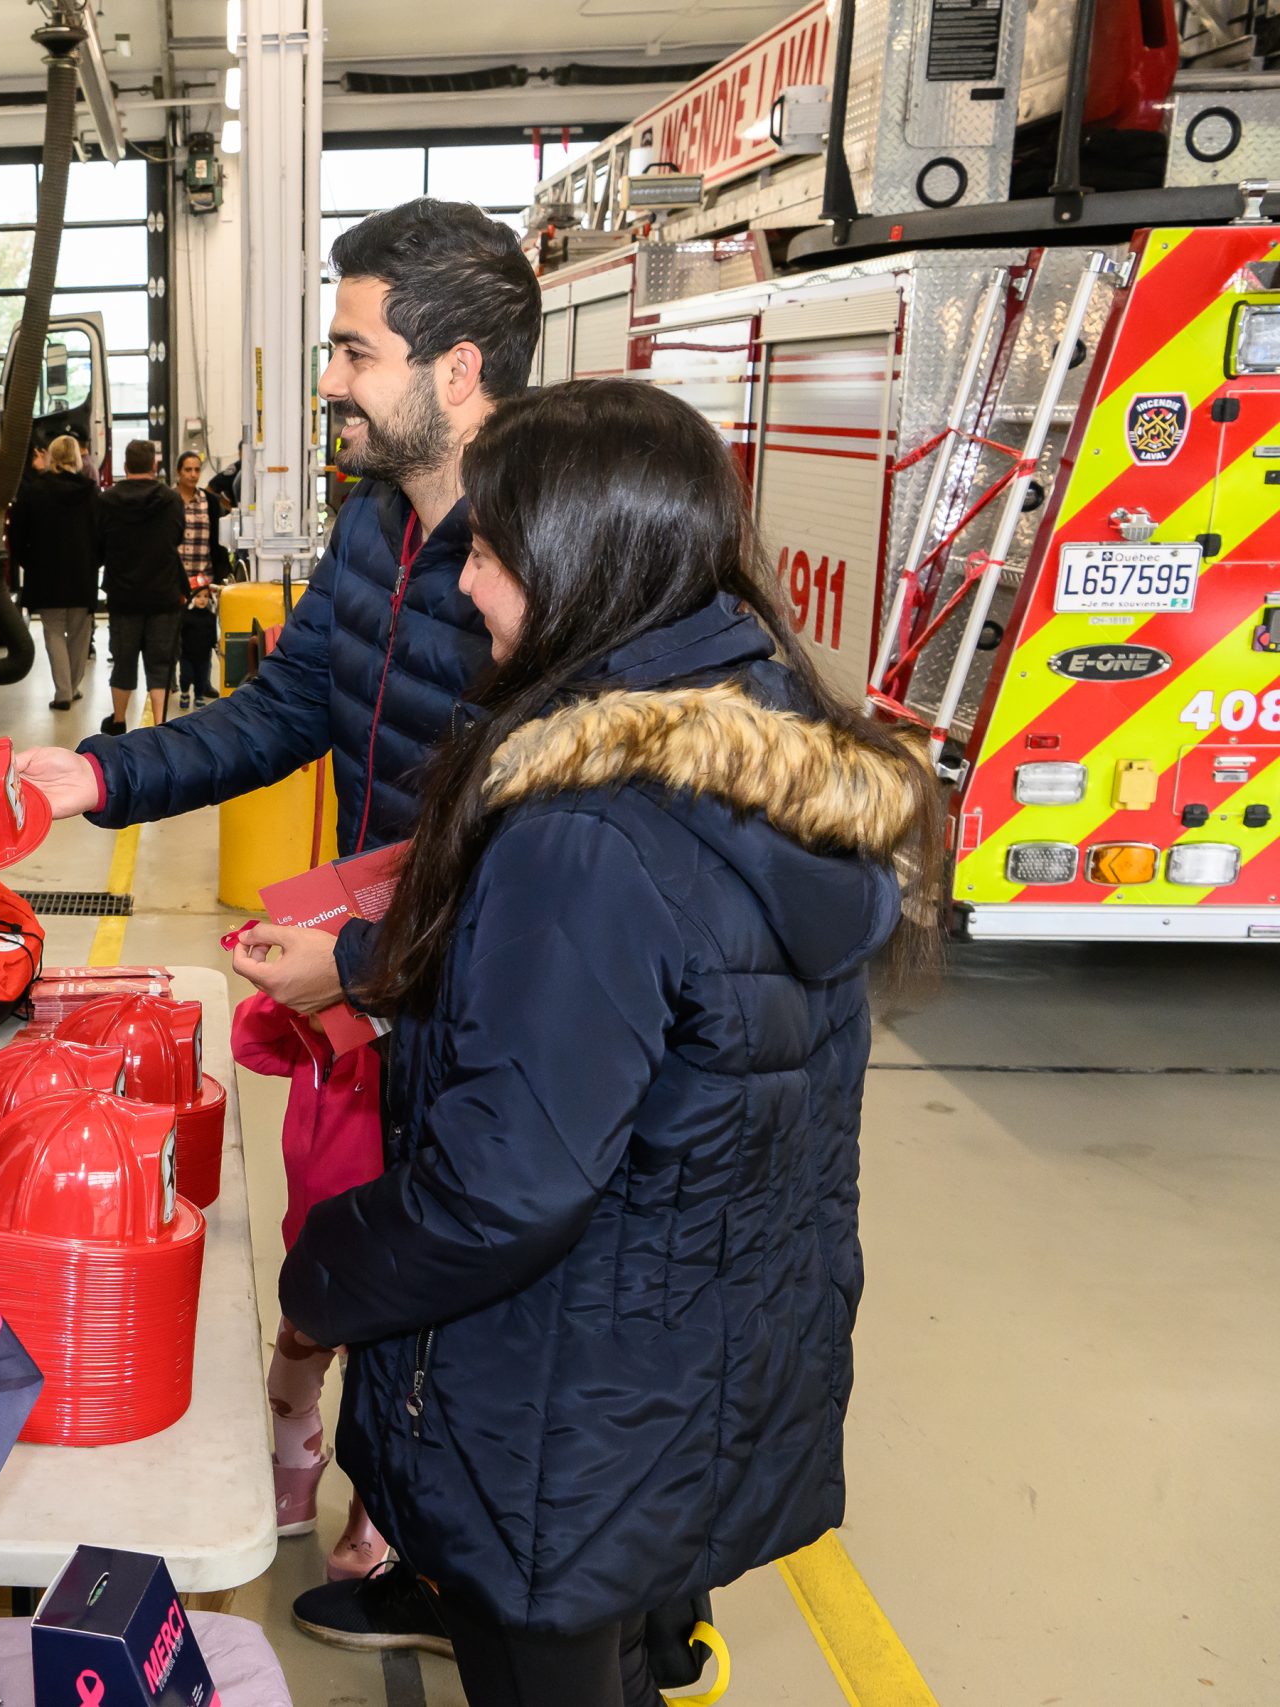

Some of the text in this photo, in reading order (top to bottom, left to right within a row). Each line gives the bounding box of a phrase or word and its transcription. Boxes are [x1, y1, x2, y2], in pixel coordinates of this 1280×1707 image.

[659, 62, 751, 174] INCENDIE
[1136, 398, 1181, 412] INCENDIE
[1140, 451, 1167, 460] LAVAL
[1115, 552, 1160, 562] Québec
[1063, 564, 1193, 595] L657595
[1068, 653, 1153, 673] E-ONE
[1179, 689, 1280, 732] 408
[277, 914, 293, 925] Les
[295, 904, 348, 929] tractions
[143, 1599, 185, 1695] MERCI
